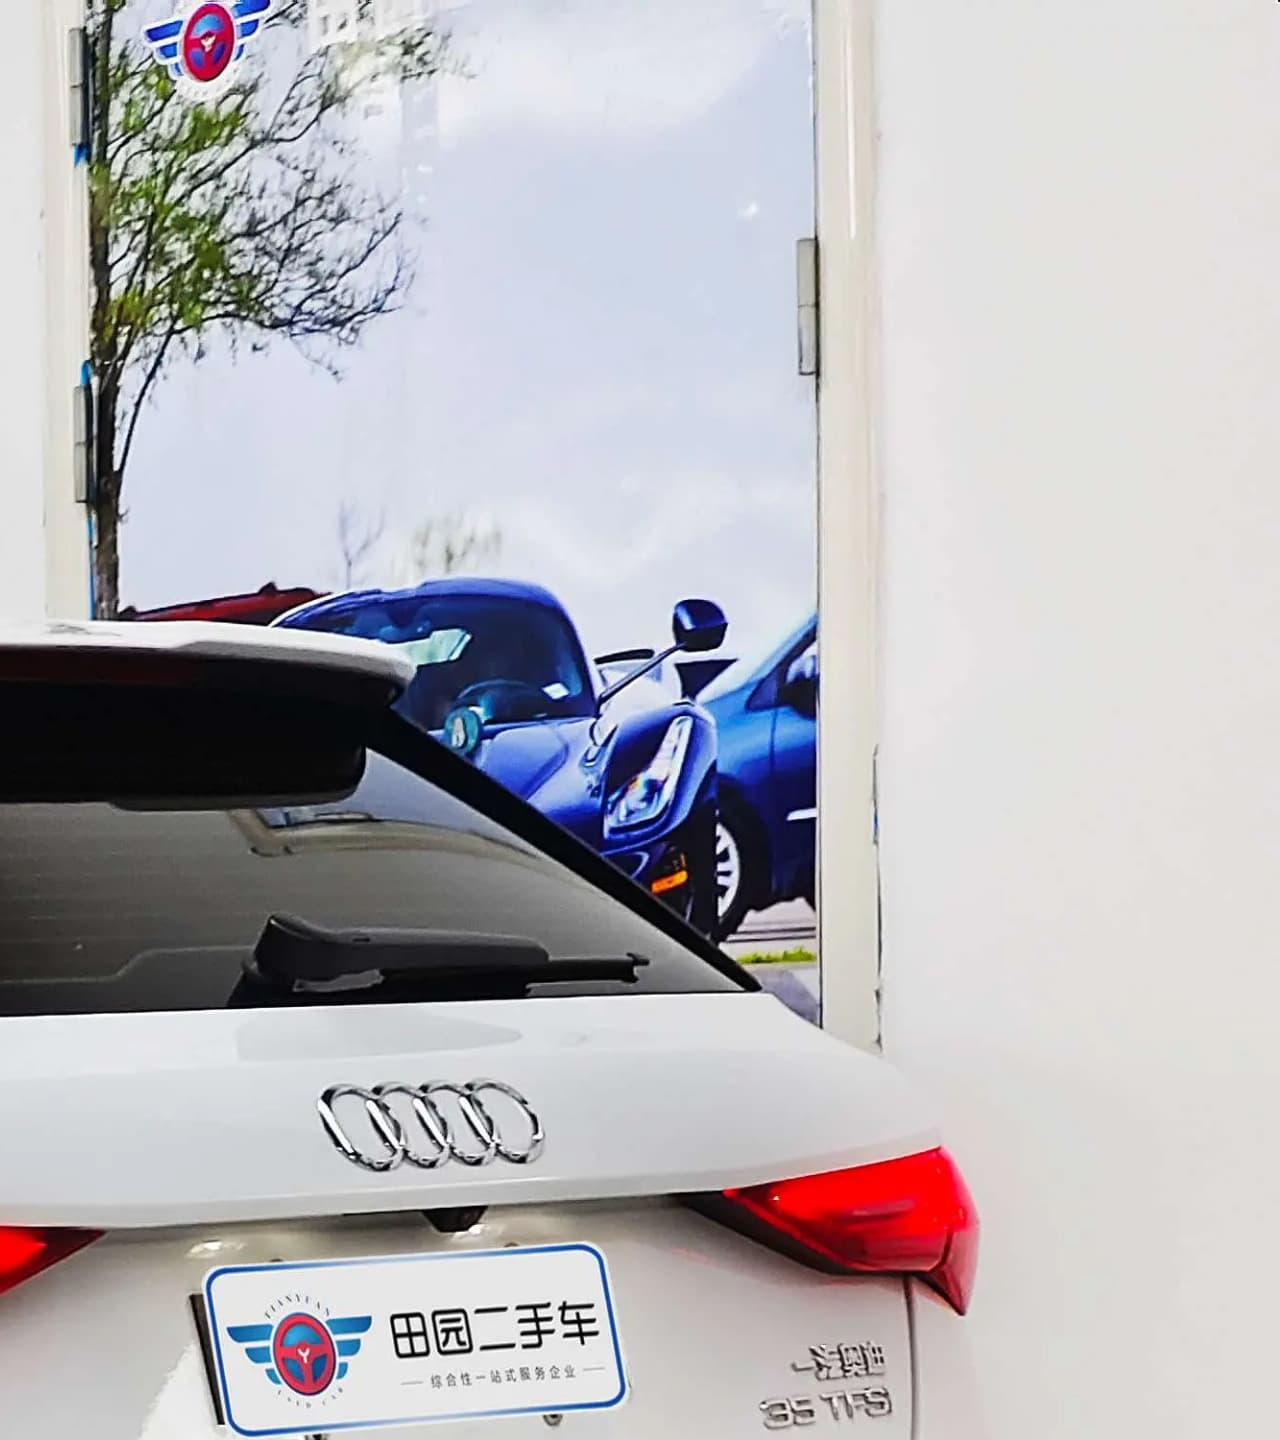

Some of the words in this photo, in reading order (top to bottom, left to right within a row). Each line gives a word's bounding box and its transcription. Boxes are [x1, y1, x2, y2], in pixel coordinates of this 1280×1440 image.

[389, 1300, 600, 1359] 田园二手车
[430, 1364, 577, 1389] 综合性一站式服务企业
[759, 1395, 816, 1430] 35
